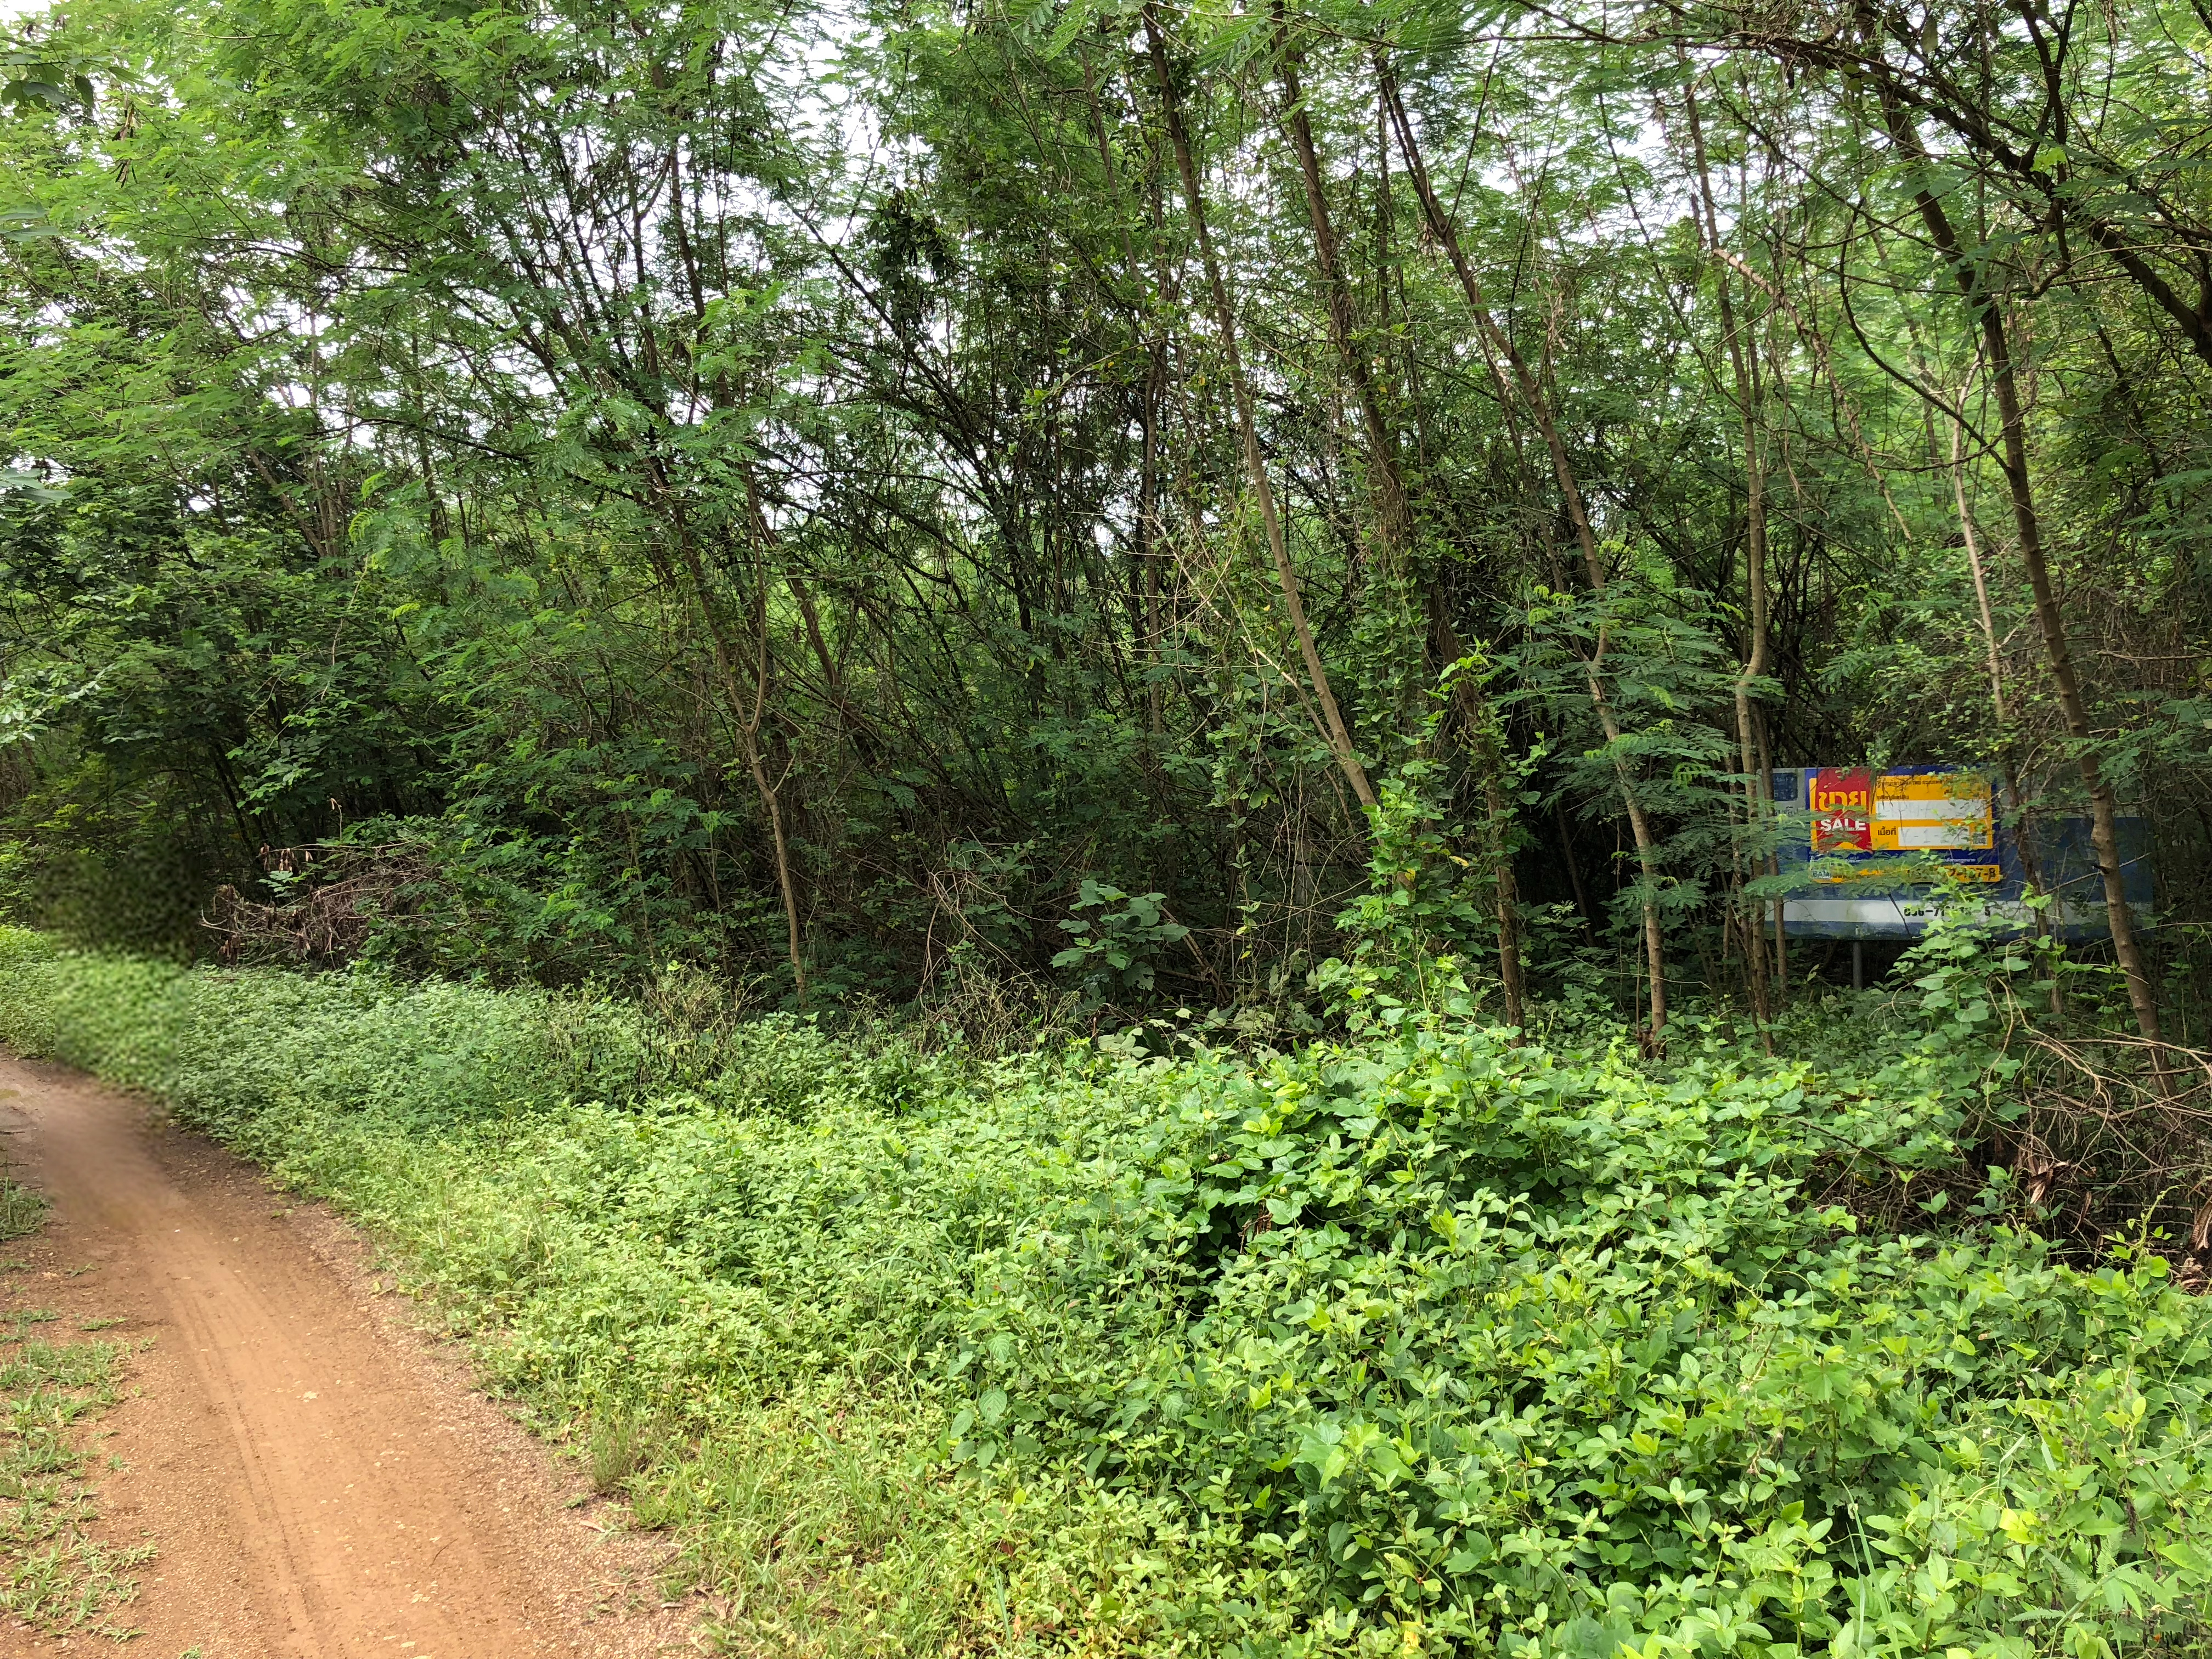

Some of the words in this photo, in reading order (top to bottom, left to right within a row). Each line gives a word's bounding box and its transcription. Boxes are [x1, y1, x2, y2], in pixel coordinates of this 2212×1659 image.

[1818, 791, 1866, 812] ขาย
[1820, 818, 1866, 832] SALE
[1878, 826, 1897, 836] เนื้อที่
